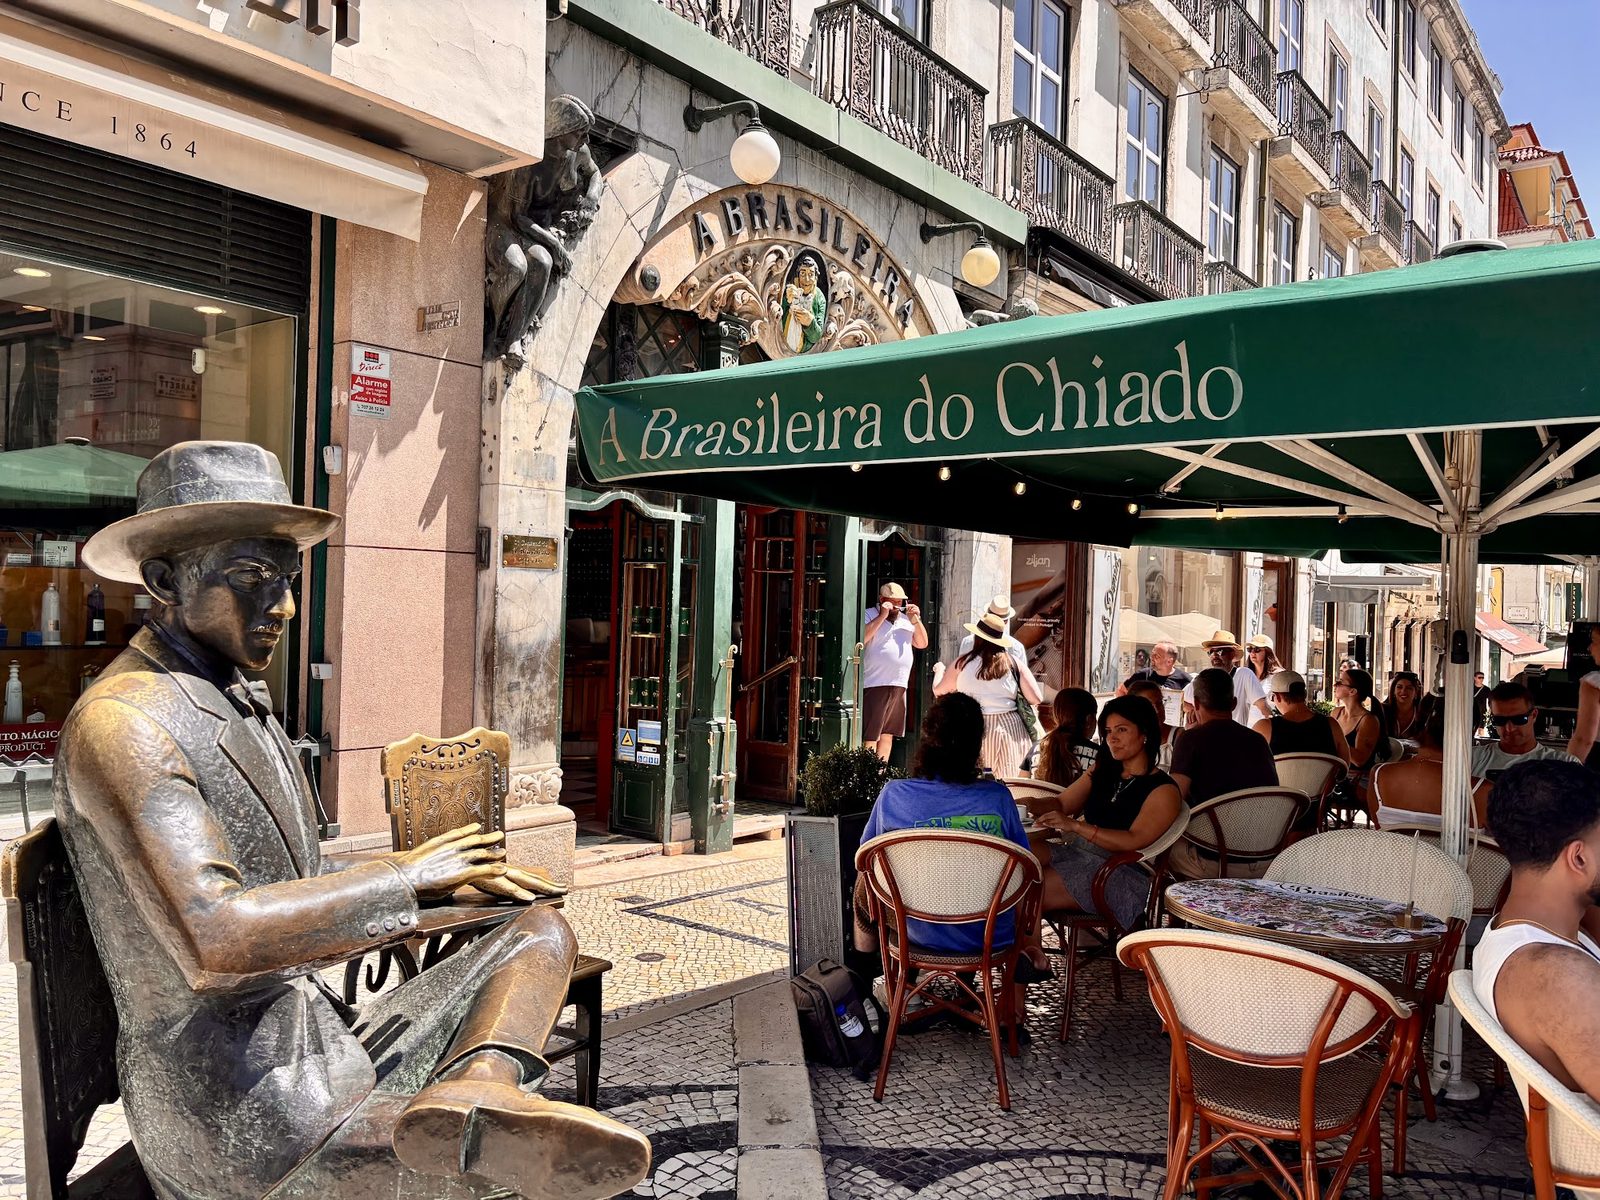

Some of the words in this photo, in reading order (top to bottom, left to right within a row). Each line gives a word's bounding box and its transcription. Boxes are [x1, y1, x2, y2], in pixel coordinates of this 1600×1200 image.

[110, 116, 197, 158] 1864
[694, 211, 718, 251] A
[720, 191, 914, 328] BRASILEIRA
[355, 376, 388, 388] Alarme
[600, 406, 627, 466] A
[639, 391, 883, 460] Brasileira
[903, 373, 975, 444] do
[997, 339, 1244, 437] Chiado
[1025, 553, 1051, 568] zilian
